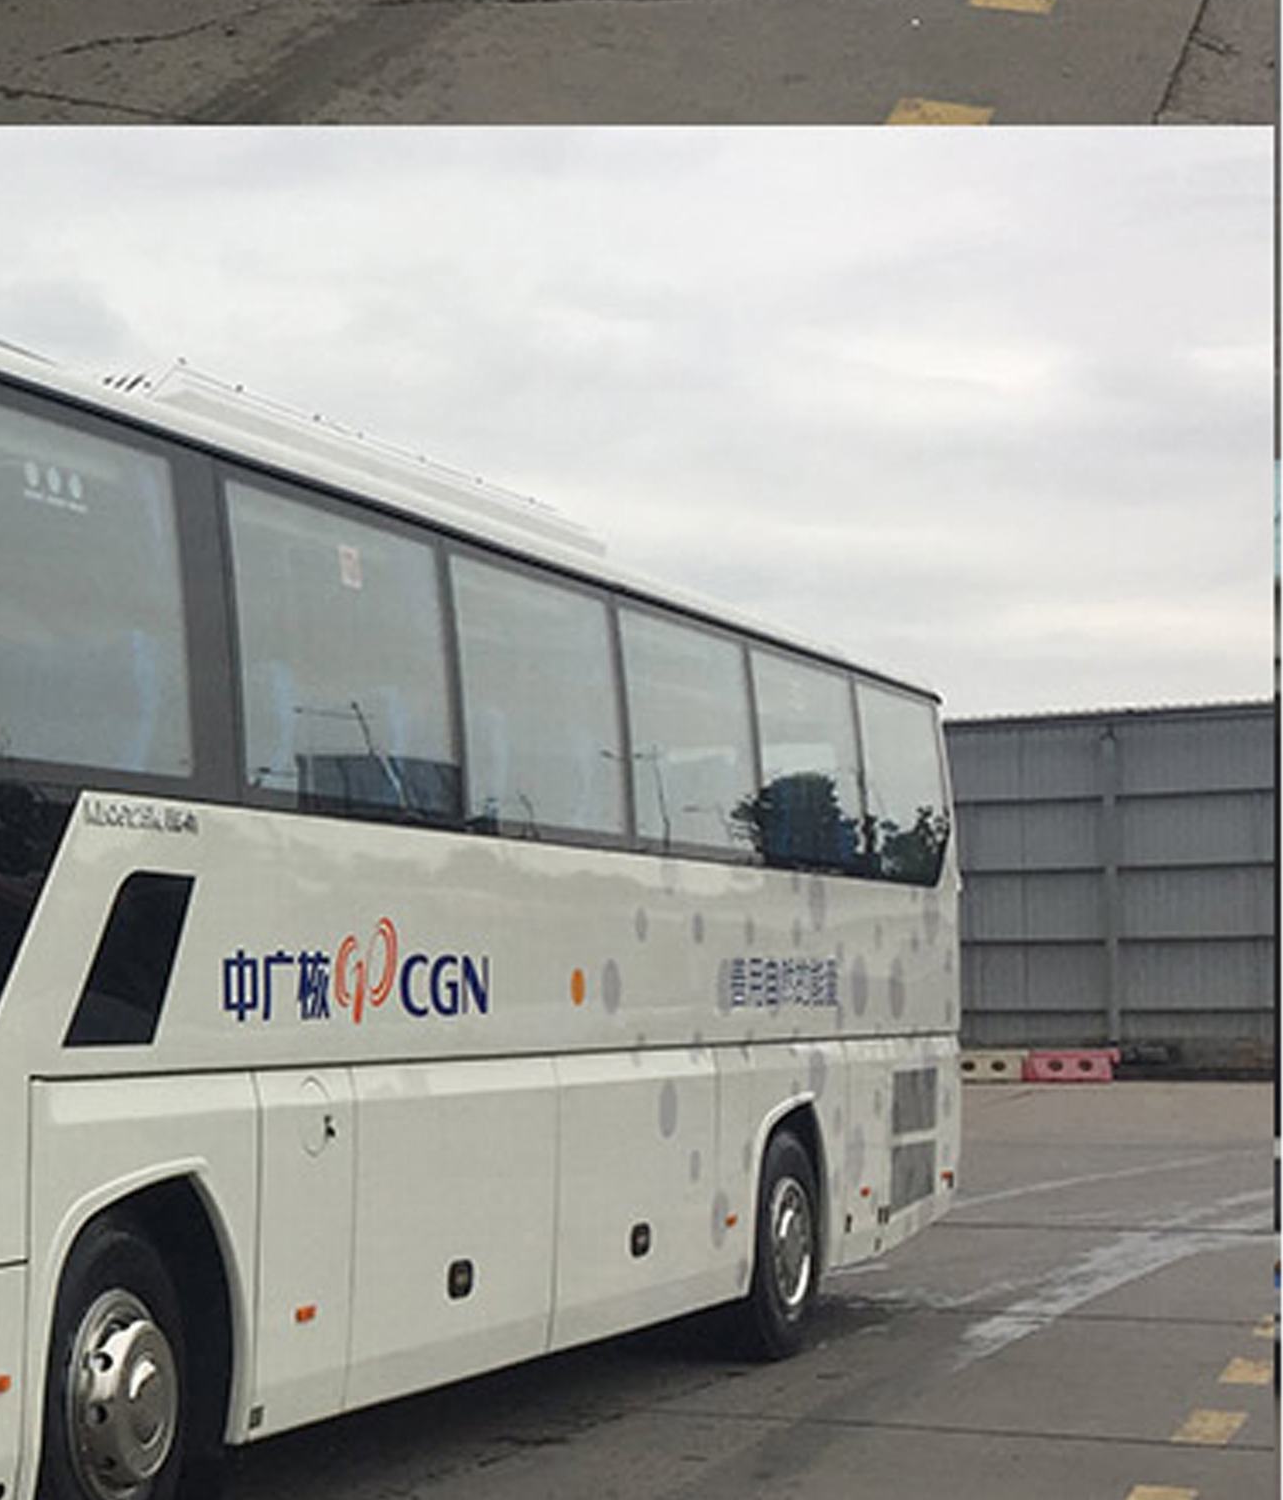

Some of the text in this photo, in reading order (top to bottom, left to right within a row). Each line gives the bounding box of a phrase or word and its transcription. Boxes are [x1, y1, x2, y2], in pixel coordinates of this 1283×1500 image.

[223, 949, 489, 1022] 中广核 CGN
